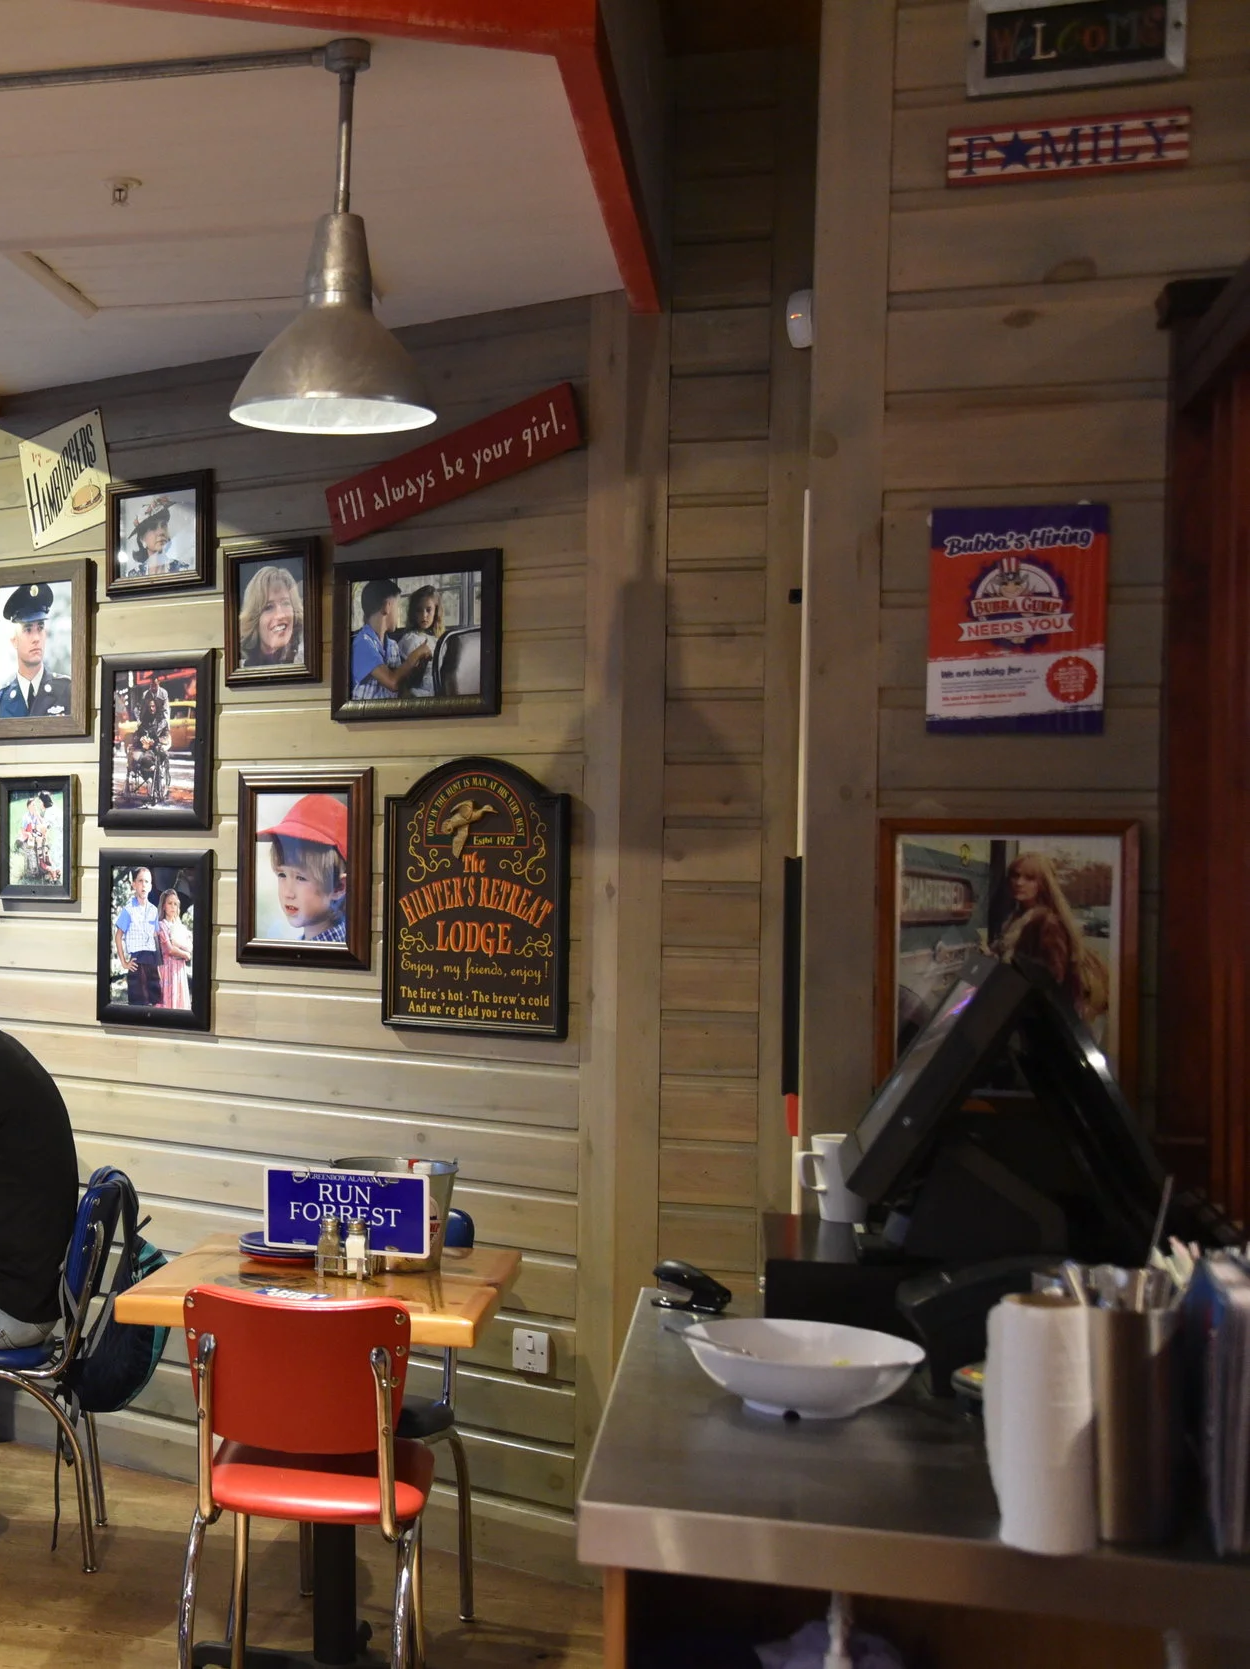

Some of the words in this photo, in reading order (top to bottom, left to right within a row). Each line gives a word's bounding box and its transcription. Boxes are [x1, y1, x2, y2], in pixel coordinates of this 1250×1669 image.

[338, 487, 366, 524] I'll
[373, 469, 436, 511] always
[440, 452, 465, 481] be
[471, 437, 513, 480] your
[521, 402, 566, 458] girl.
[26, 423, 97, 536] HAMBURGERS
[944, 531, 1026, 559] Bubba's
[1027, 525, 1095, 551] Hiring
[967, 621, 1024, 637] NEEDS
[1028, 617, 1064, 632] YOU
[435, 795, 447, 810] THE
[445, 781, 462, 798] HUNT
[463, 777, 470, 788] IS
[472, 777, 487, 787] MAN
[489, 780, 497, 791] AT
[497, 785, 510, 798] HIS
[496, 835, 515, 846] 1927
[462, 851, 486, 874] The
[398, 876, 476, 927] HUNTER'S
[478, 877, 554, 929] RETREAT
[435, 920, 512, 958] LODGE
[400, 952, 439, 980] Enjoy,
[442, 963, 461, 981] my
[463, 957, 507, 982] friends,
[399, 986, 418, 999] The
[447, 989, 463, 1002] hot
[471, 990, 489, 1003] The
[492, 991, 526, 1006] brew's
[527, 995, 550, 1007] cold
[408, 1001, 427, 1013] And
[429, 1002, 456, 1015] we're
[457, 1004, 479, 1019] glad
[481, 1006, 512, 1021] you're
[514, 1008, 540, 1021] here.
[318, 1182, 372, 1205] RUN
[289, 1201, 402, 1228] FORREST
